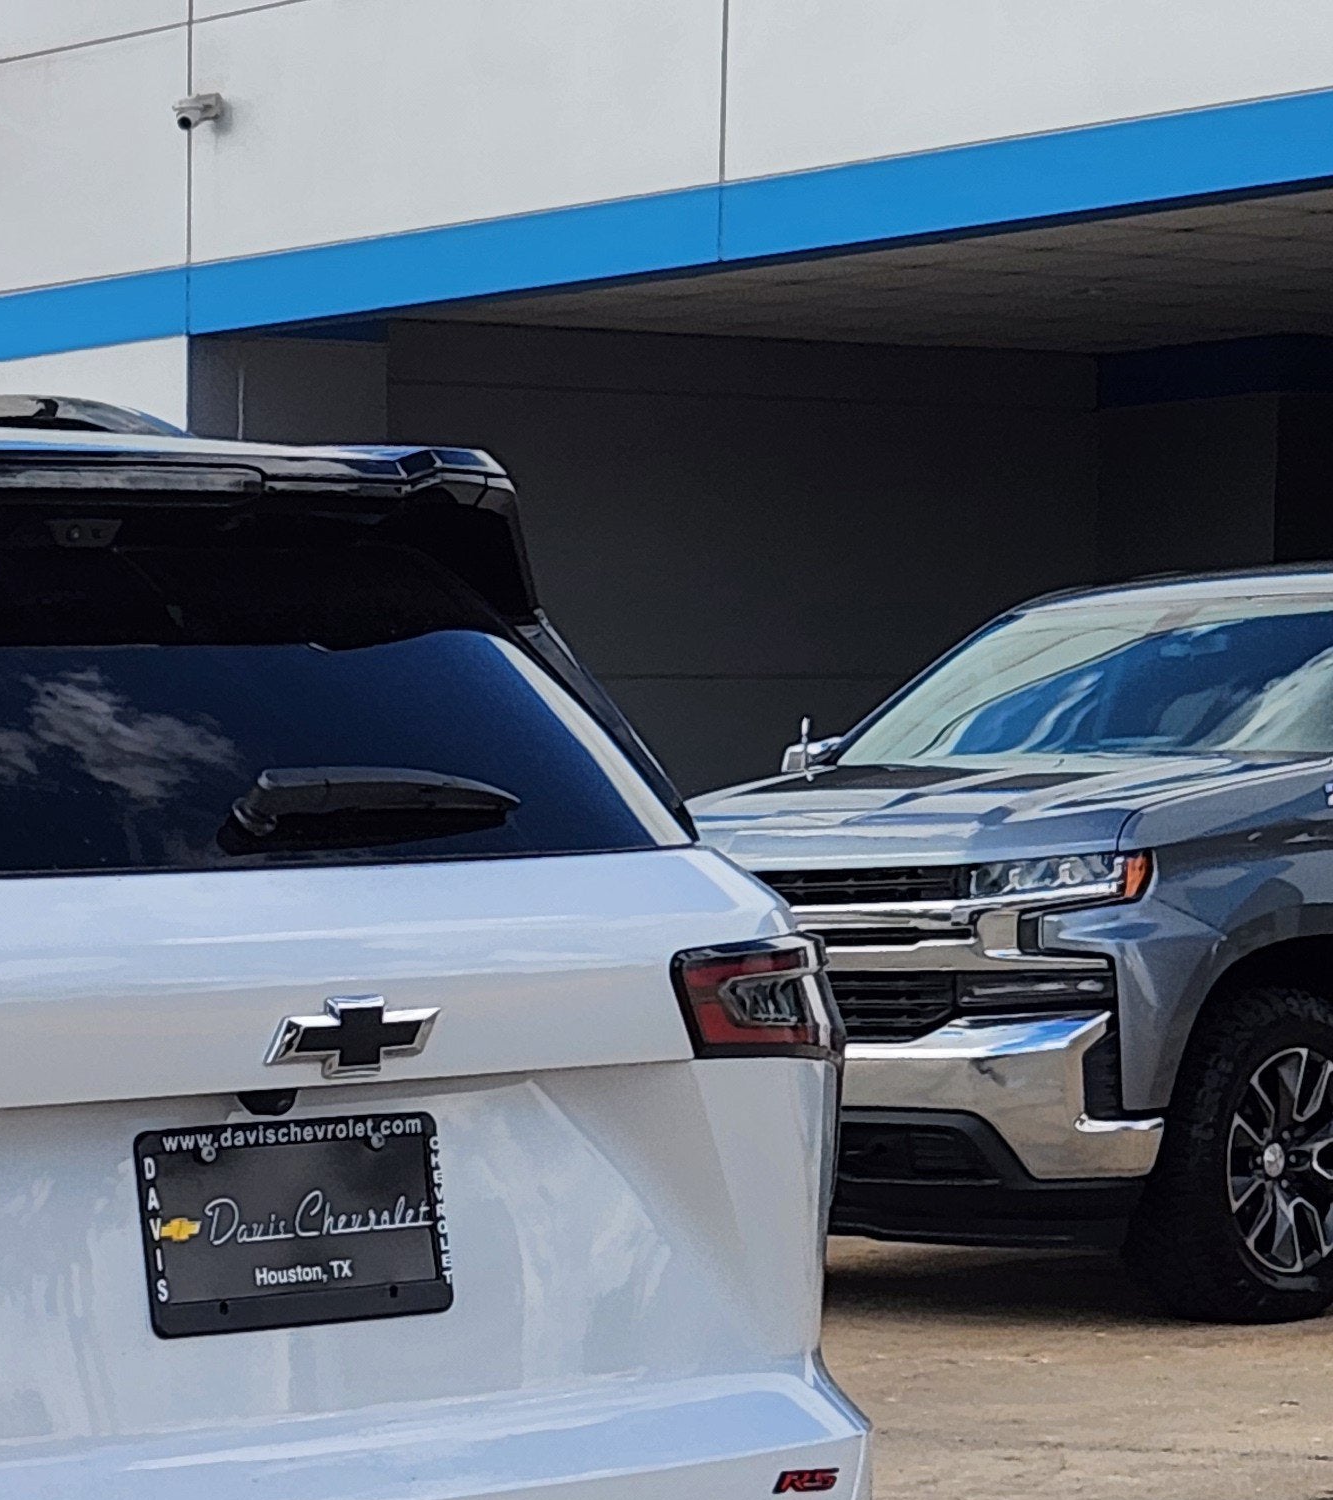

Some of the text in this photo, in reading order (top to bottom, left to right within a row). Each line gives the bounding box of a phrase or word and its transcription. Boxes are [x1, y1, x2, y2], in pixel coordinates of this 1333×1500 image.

[162, 1117, 423, 1152] www.davischevroletcom
[143, 1156, 169, 1303] DAVIS
[204, 1190, 434, 1246] Davis Chevrolet
[254, 1259, 353, 1287] Houston, TX
[772, 1467, 840, 1495] RS
